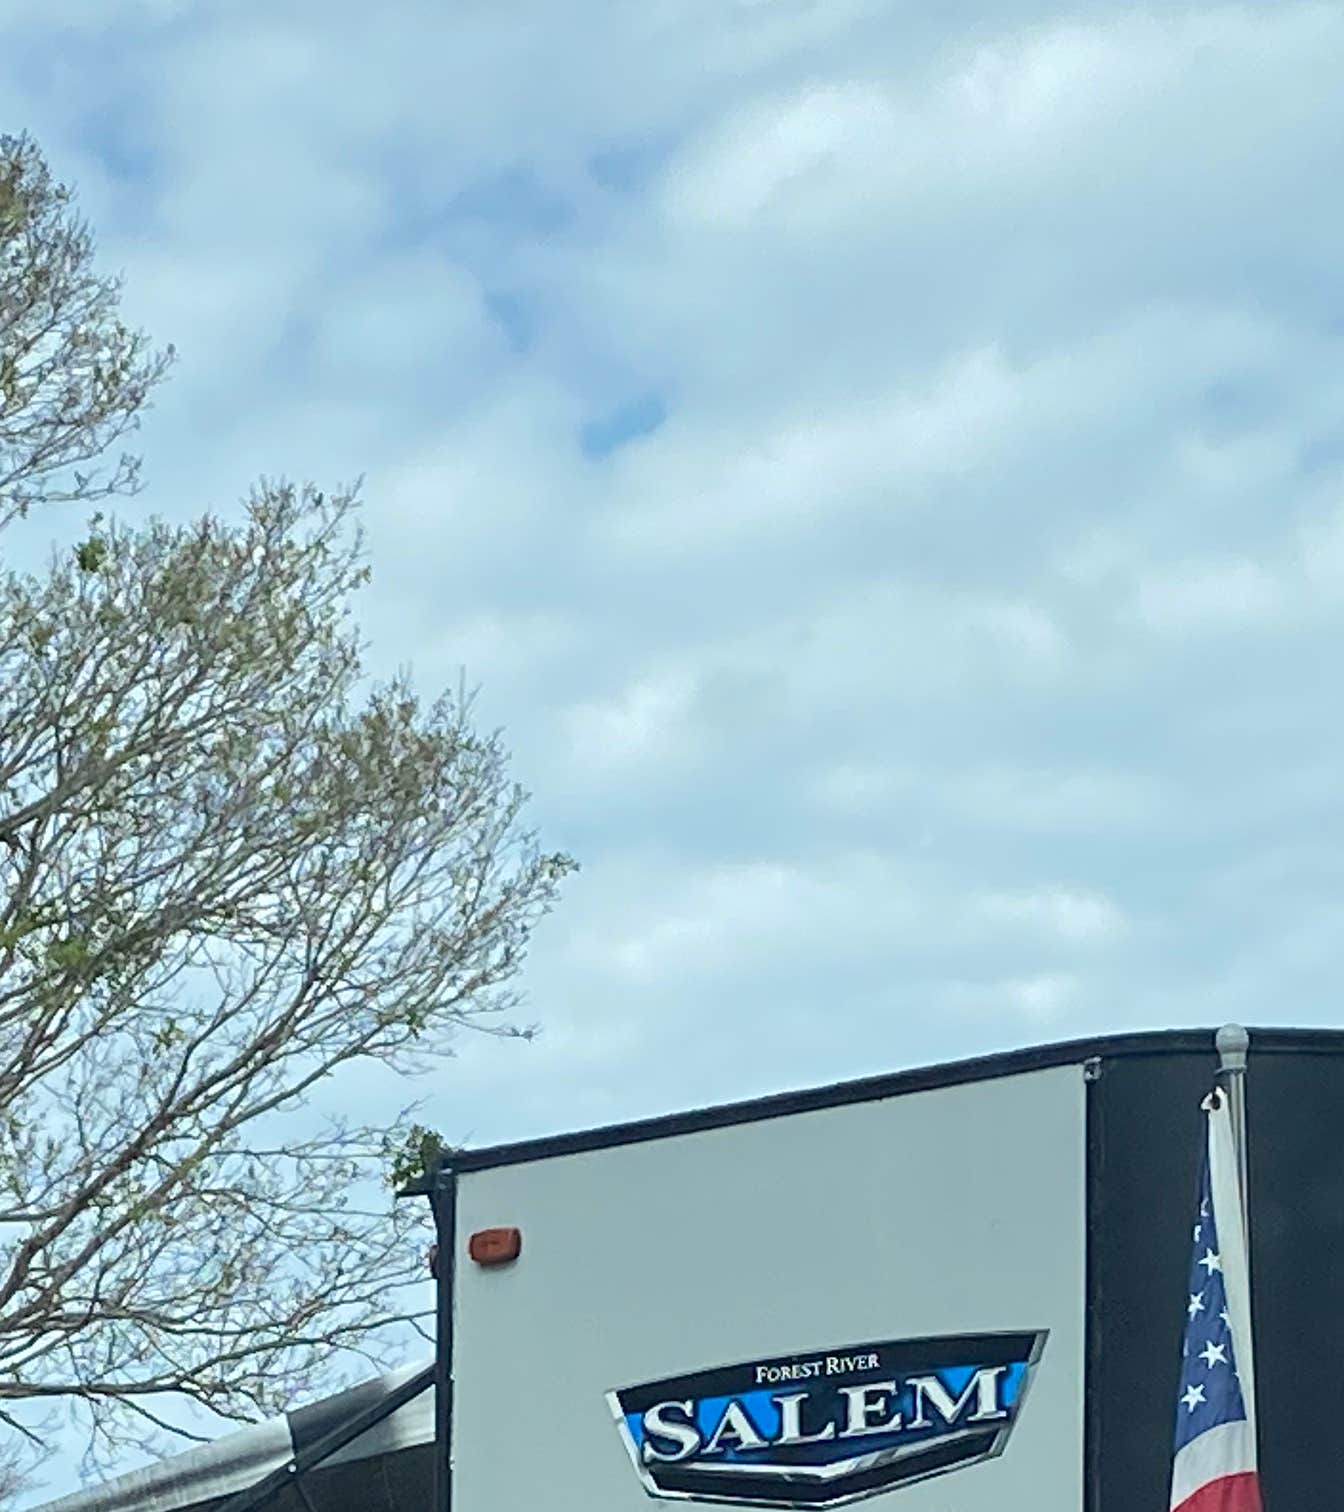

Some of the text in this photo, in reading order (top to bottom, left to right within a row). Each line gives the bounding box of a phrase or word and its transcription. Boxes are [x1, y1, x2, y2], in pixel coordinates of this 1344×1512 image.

[755, 1353, 880, 1383] FOREST RIVER
[642, 1366, 1007, 1462] SALEM
